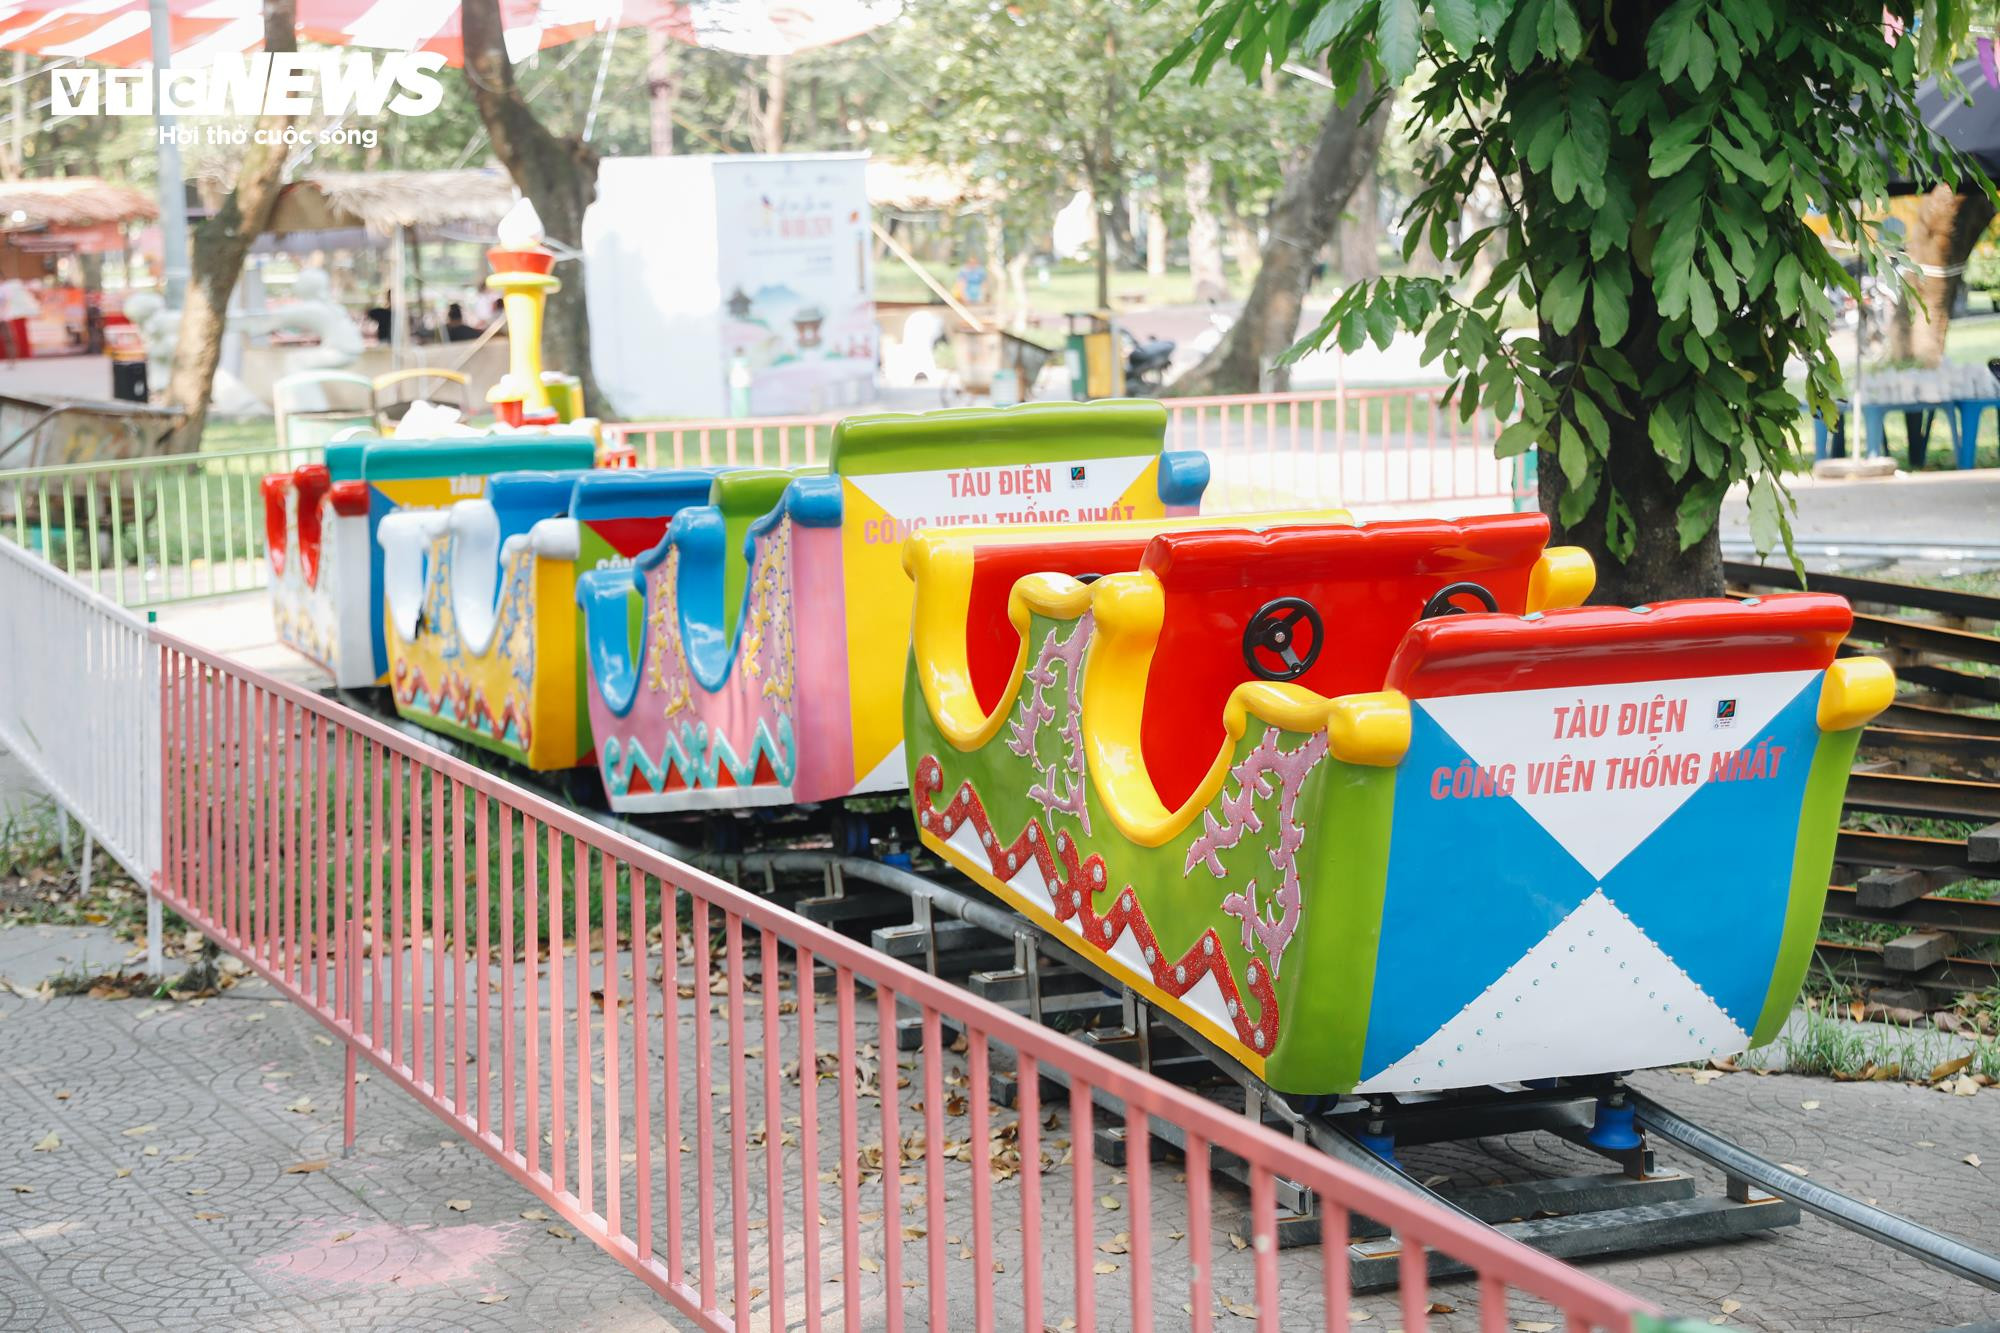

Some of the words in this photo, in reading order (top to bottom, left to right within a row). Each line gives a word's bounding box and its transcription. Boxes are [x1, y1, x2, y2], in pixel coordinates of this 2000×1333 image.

[947, 468, 990, 498] TÀU
[999, 464, 1052, 500] ĐIỆN
[1554, 698, 1610, 740] TÀU
[1616, 694, 1688, 741] ĐIỆN
[1430, 758, 1517, 801] CÔNG
[1527, 754, 1596, 795] VIÊN
[1606, 743, 1701, 791] THỐNG
[1707, 735, 1786, 784] NHẤT
